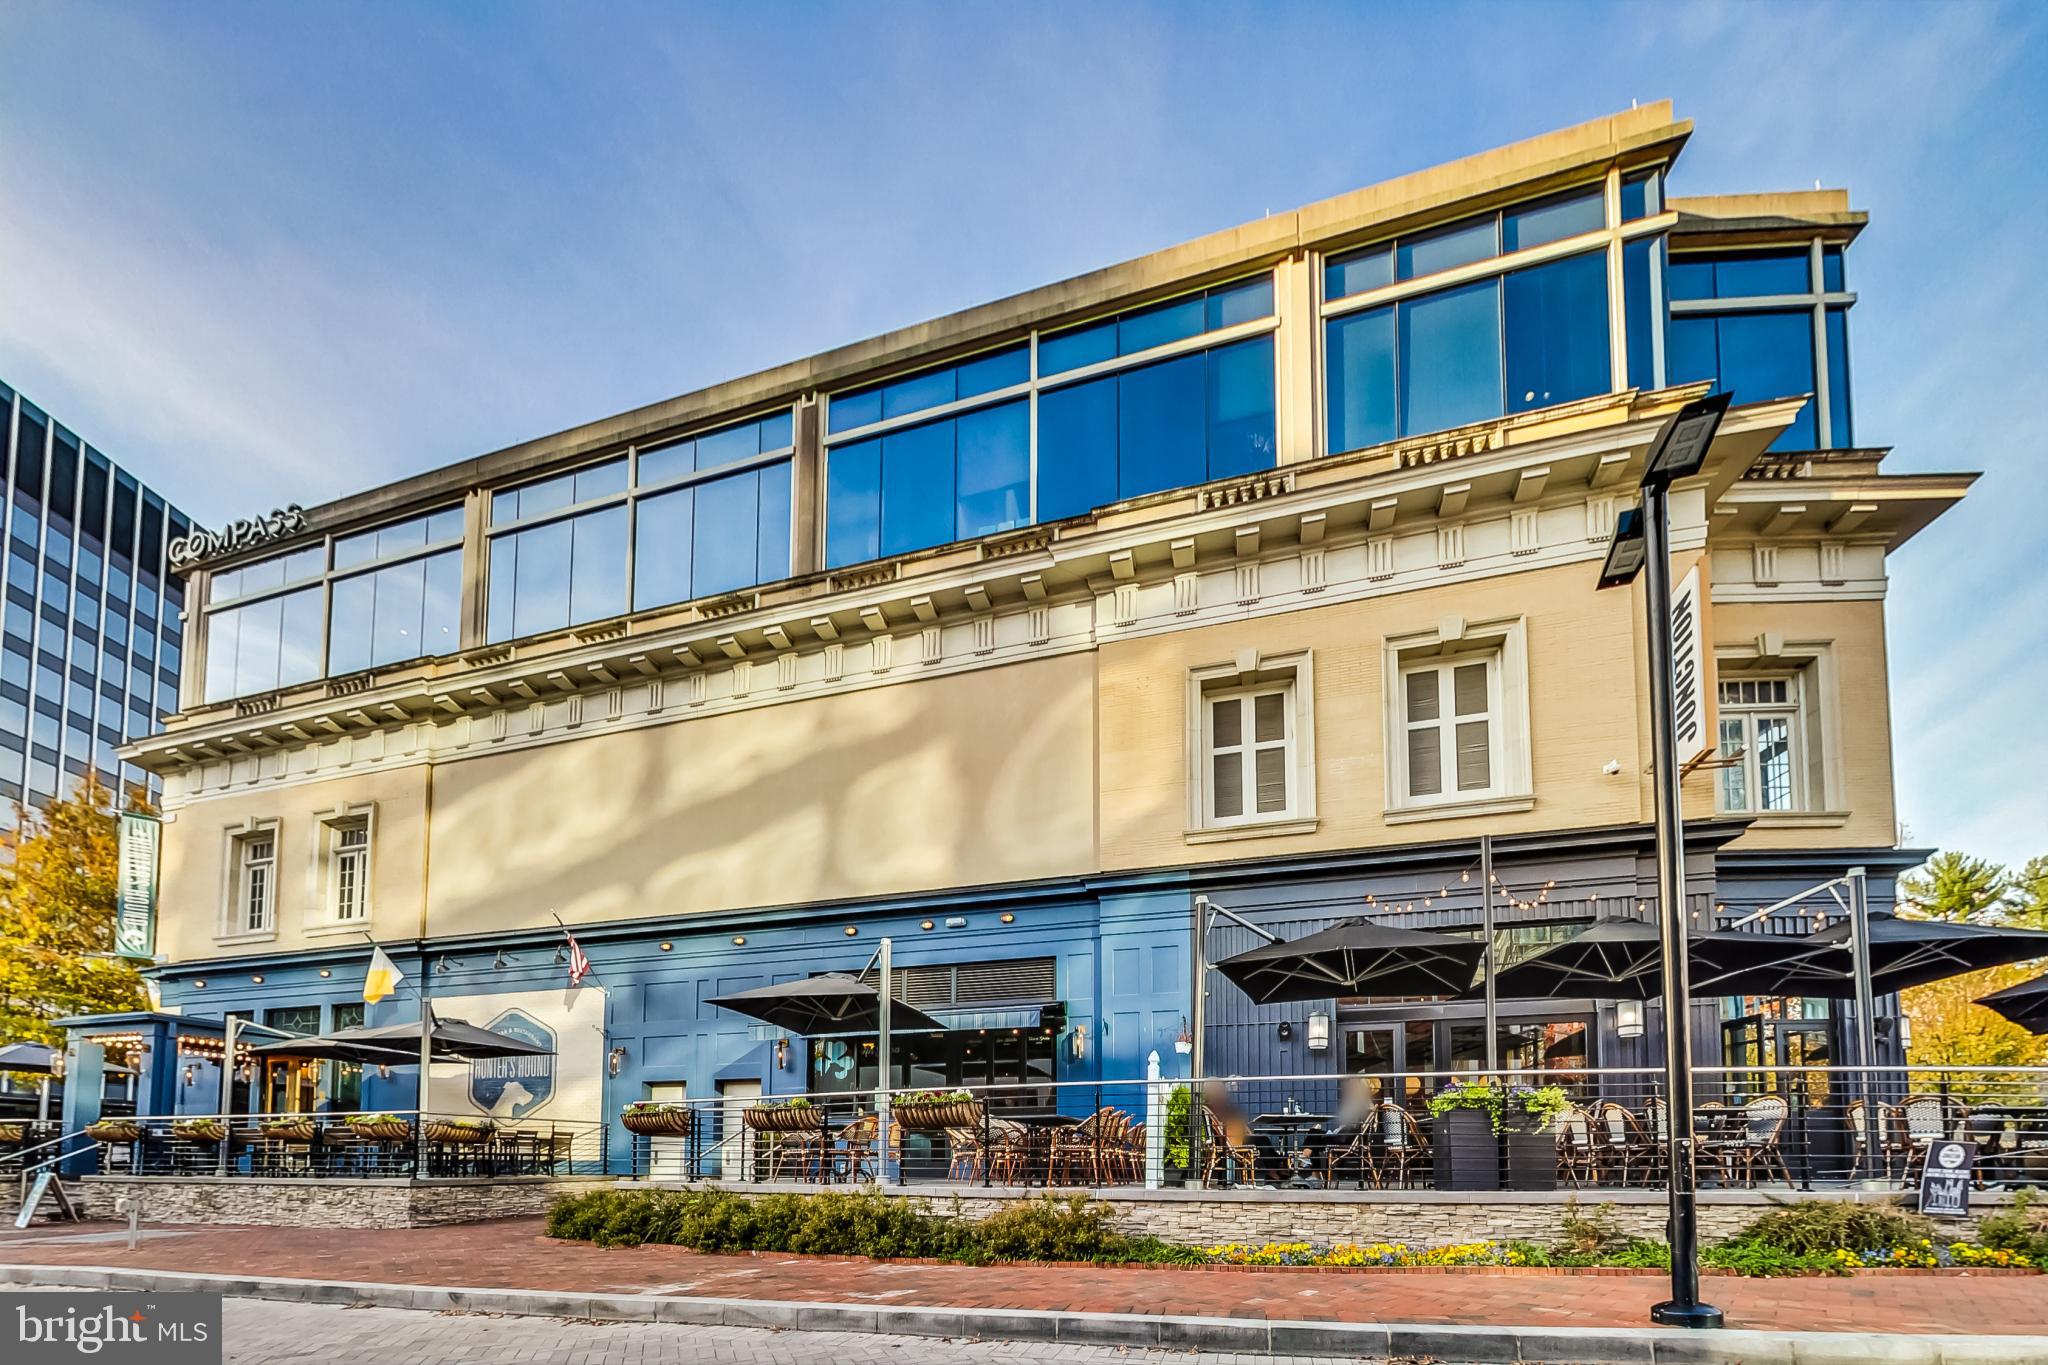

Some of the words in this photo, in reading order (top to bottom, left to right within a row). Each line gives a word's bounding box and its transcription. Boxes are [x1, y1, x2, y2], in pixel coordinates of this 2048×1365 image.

[169, 503, 307, 564] COMPASS
[1671, 589, 1698, 743] JUNCTION
[123, 887, 150, 926] HOUND
[518, 1055, 550, 1078] HOUND
